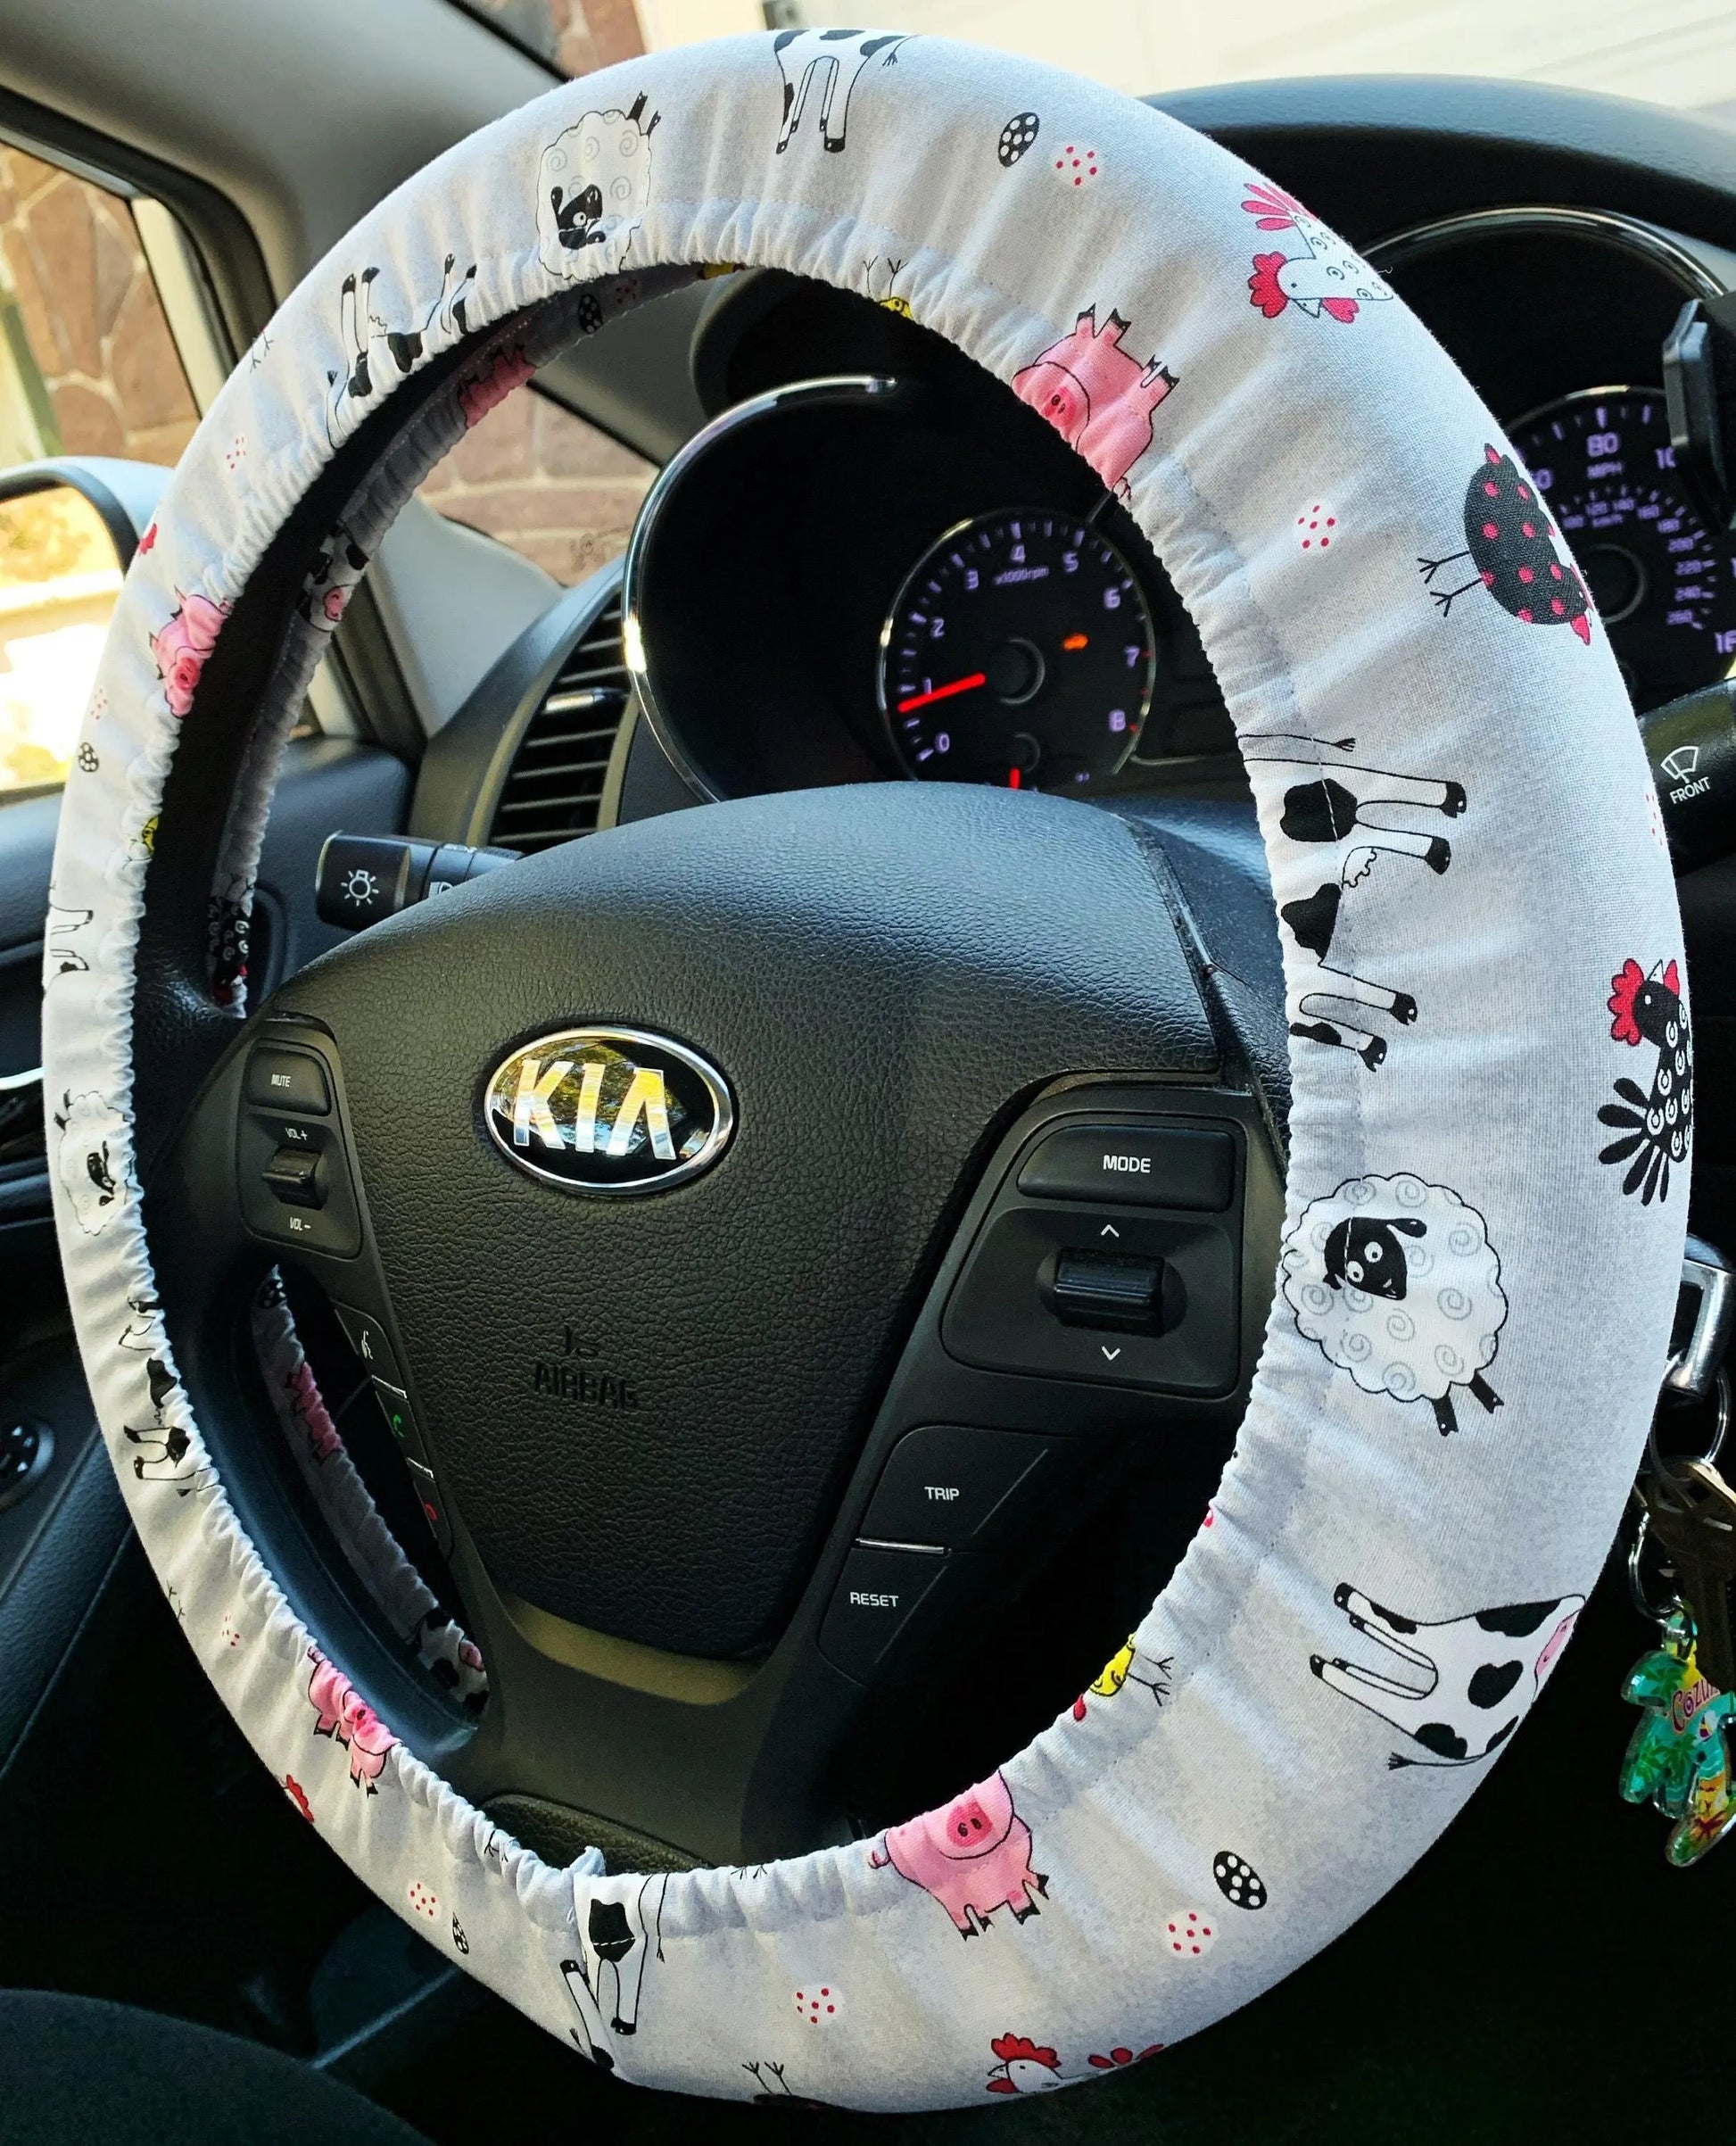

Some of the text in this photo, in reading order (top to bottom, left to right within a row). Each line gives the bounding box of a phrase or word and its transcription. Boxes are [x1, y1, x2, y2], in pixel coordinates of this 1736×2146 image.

[1587, 432, 1619, 457] 80
[1656, 447, 1676, 469] 10
[1011, 543, 1026, 563] 4
[1063, 551, 1079, 573] 5
[965, 568, 980, 590] 3
[1104, 586, 1121, 609] 6
[931, 617, 945, 639] 2
[1715, 629, 1736, 654] 16
[1125, 644, 1140, 667] 7
[1108, 708, 1126, 733] 8
[936, 732, 950, 753] 0
[1669, 776, 1711, 805] FRONT
[270, 1073, 292, 1088] MUTE
[512, 1058, 677, 1160] KIA
[1103, 1154, 1152, 1174] MODE
[923, 1486, 961, 1502] TRIP
[849, 1590, 899, 1608] RESET
